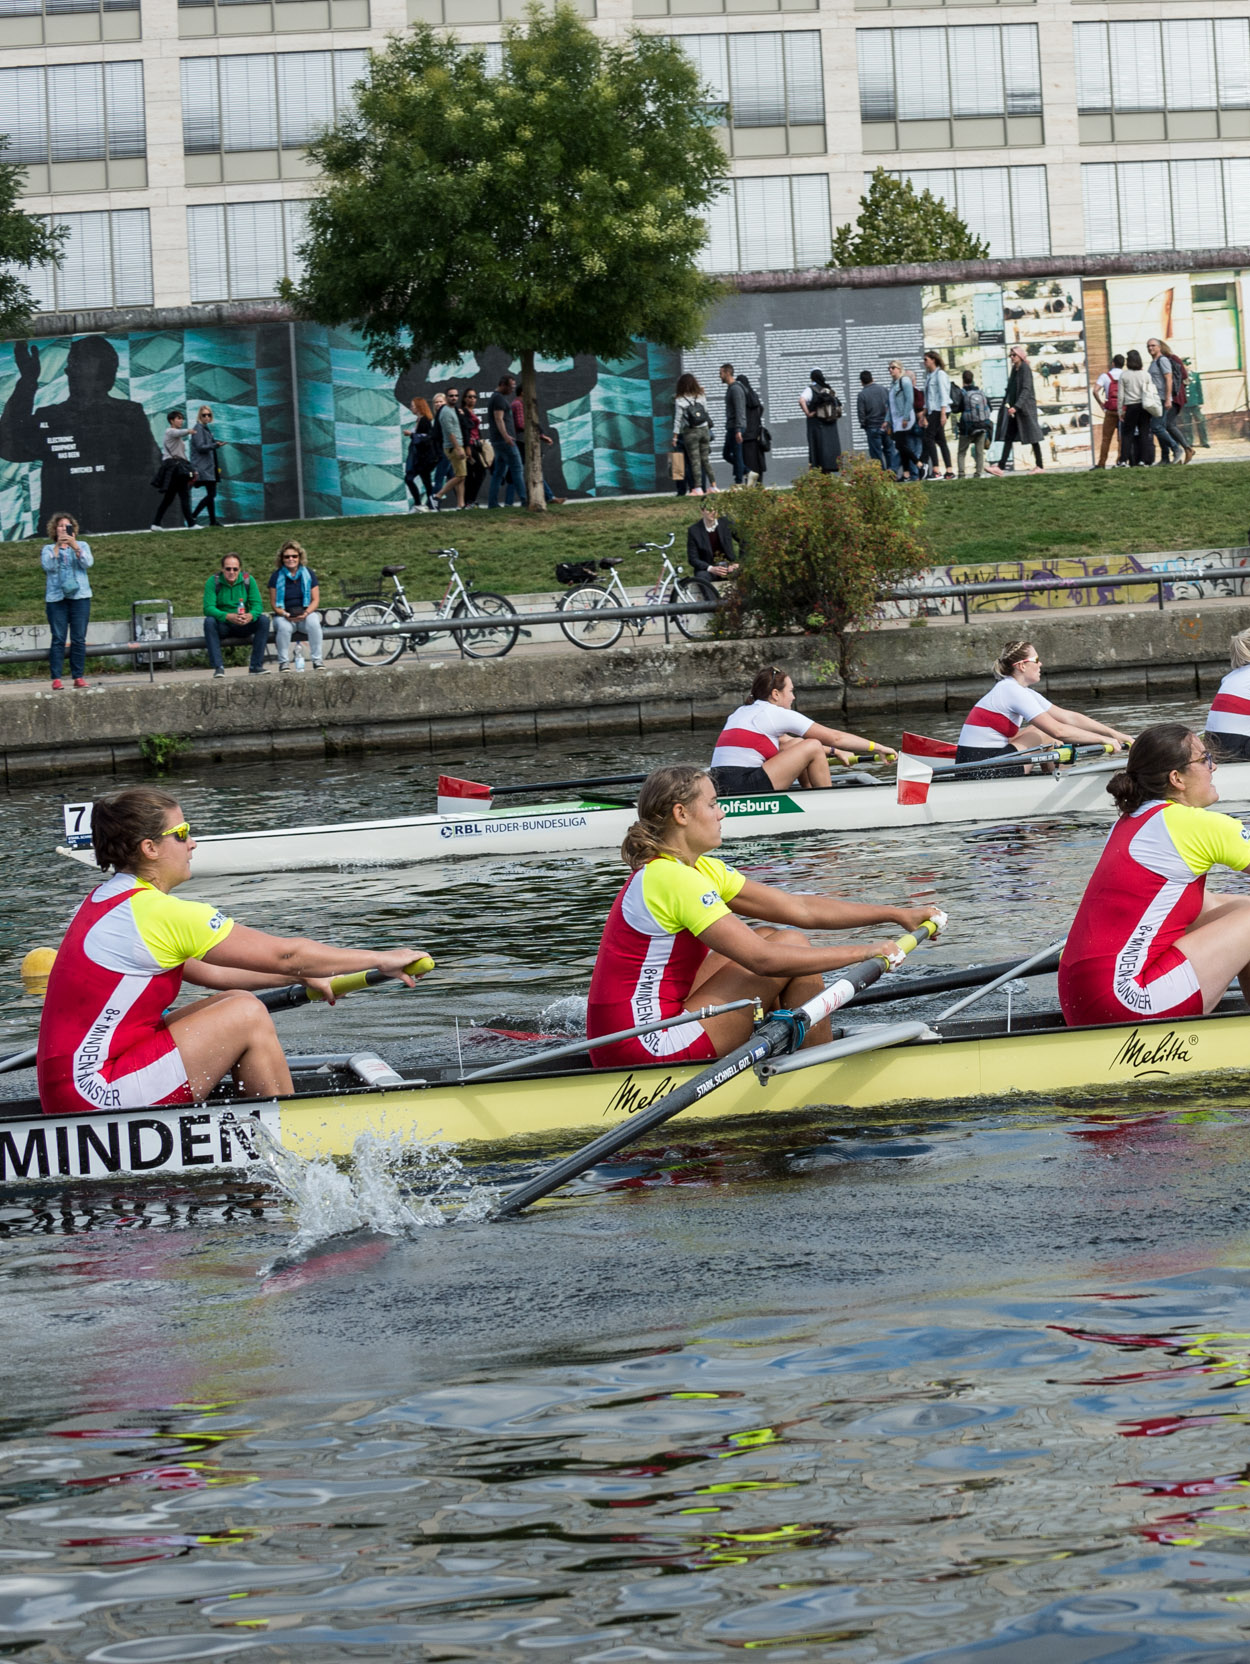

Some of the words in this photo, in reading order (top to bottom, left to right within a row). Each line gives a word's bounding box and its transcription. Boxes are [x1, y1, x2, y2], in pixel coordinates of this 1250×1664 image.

[718, 800, 780, 814] olfsburg
[69, 806, 86, 832] 7
[455, 824, 483, 835] RBL
[485, 816, 587, 835] RUDER-BUNDESLIGA
[1139, 925, 1153, 937] 8+
[643, 968, 658, 980] 8+
[104, 1008, 121, 1022] 8+
[0, 1109, 261, 1182] MINDEN
